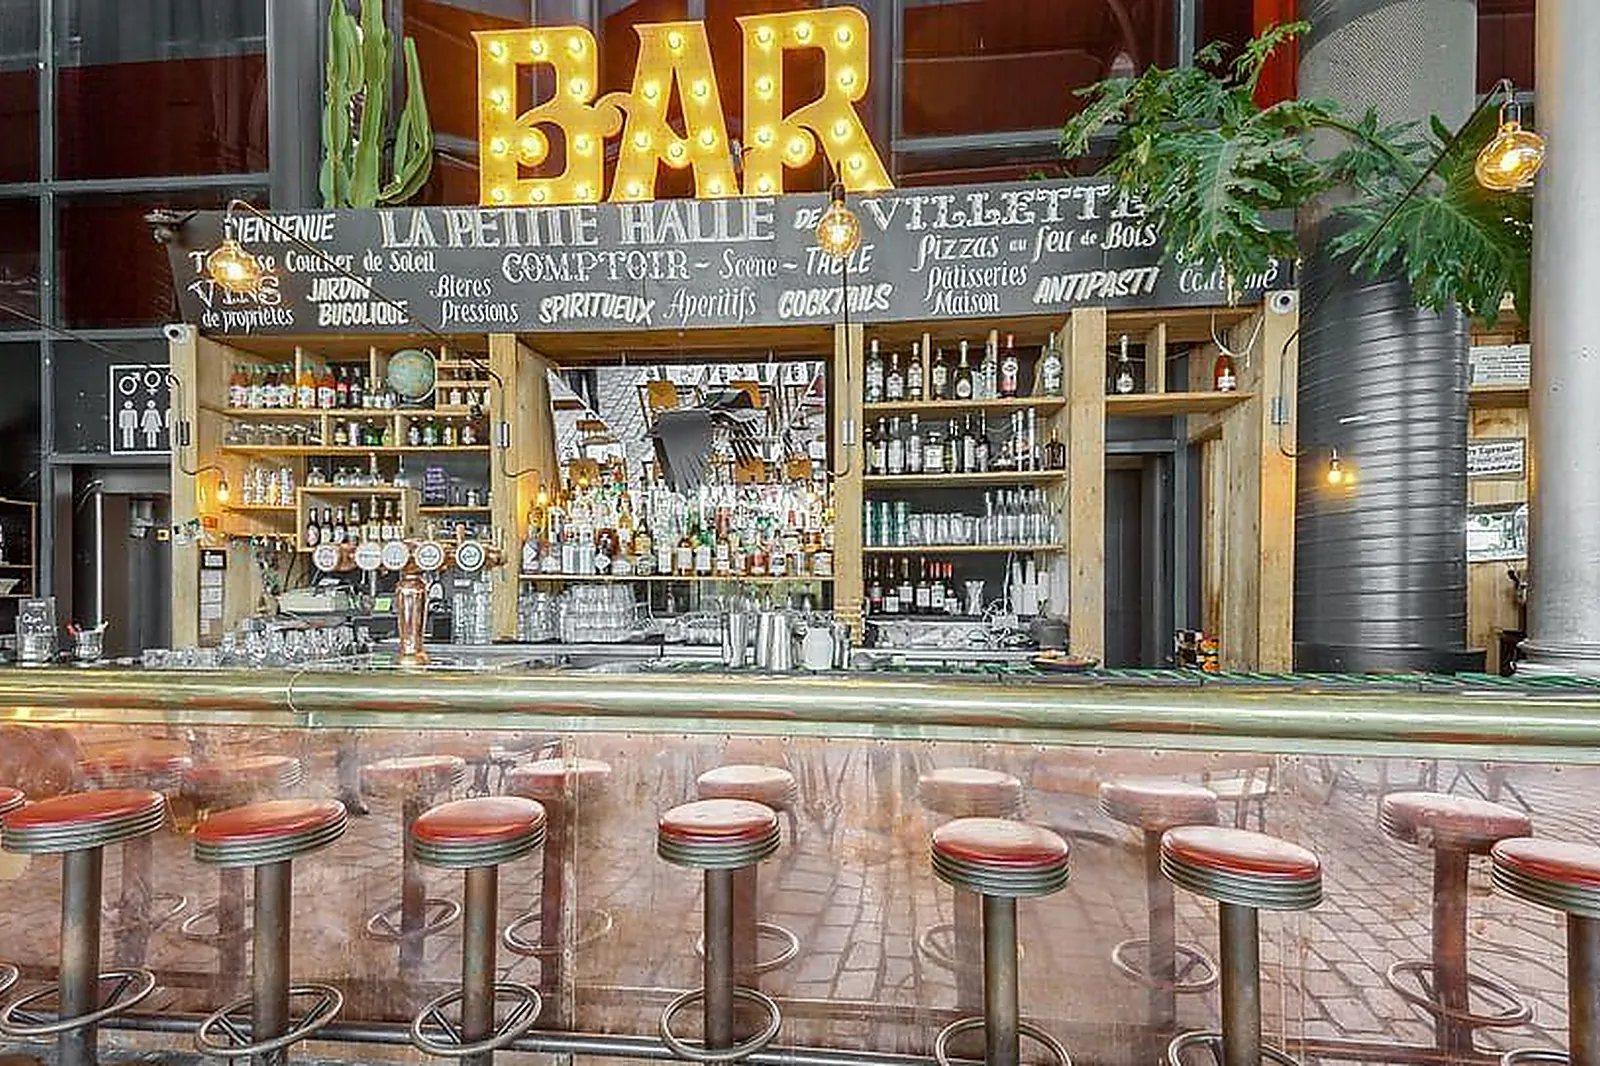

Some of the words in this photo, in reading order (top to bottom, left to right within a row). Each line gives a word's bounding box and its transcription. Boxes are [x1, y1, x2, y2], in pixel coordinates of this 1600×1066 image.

[470, 6, 895, 206] BAR
[225, 213, 336, 243] IENVENUE
[379, 208, 438, 248] LA
[442, 205, 599, 248] PETITE
[618, 198, 775, 245] HALLE
[793, 207, 822, 229] DE
[860, 184, 1146, 233] VILLETTE
[285, 249, 354, 272] Coucher
[363, 248, 383, 272] de
[389, 249, 436, 272] Soleil
[910, 233, 999, 273] Pizzas
[1009, 238, 1027, 253] au
[1031, 224, 1076, 264] feu
[1080, 231, 1097, 246] de
[1101, 220, 1157, 250] Bois
[502, 248, 691, 283] COMPTOIR
[306, 276, 373, 302] JARDIN
[780, 283, 893, 318] COCKTAILS
[1033, 266, 1160, 304] ANTIPASTI
[202, 308, 220, 327] de
[318, 300, 409, 326] BUCOLIQUE
[439, 299, 519, 329] Pressions
[539, 292, 656, 326] SPIRITUEUX
[932, 290, 1000, 316] Maison
